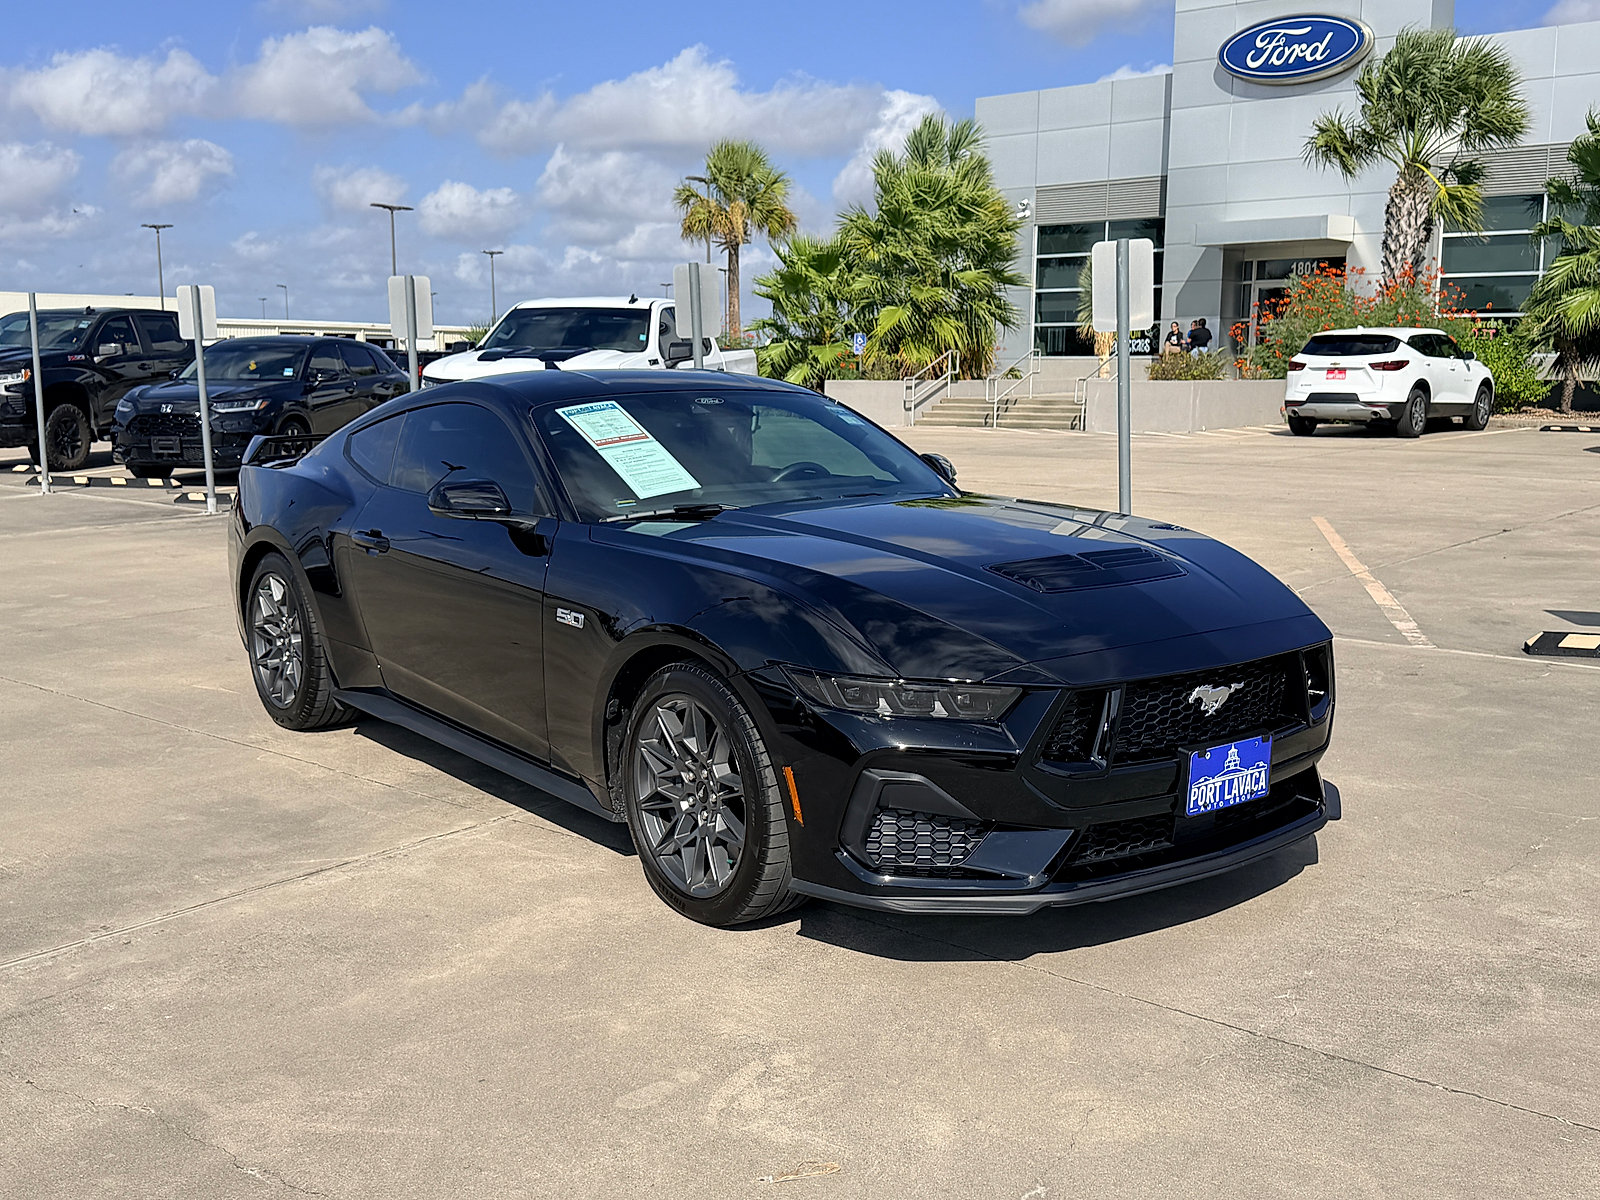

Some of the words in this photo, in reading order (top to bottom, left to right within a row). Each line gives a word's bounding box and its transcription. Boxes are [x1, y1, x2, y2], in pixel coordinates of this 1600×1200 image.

[1245, 26, 1334, 69] Ford
[1291, 261, 1318, 276] 1801
[1190, 781, 1222, 808] PORT
[1224, 770, 1266, 800] LAVACA
[1200, 802, 1223, 812] AUTO
